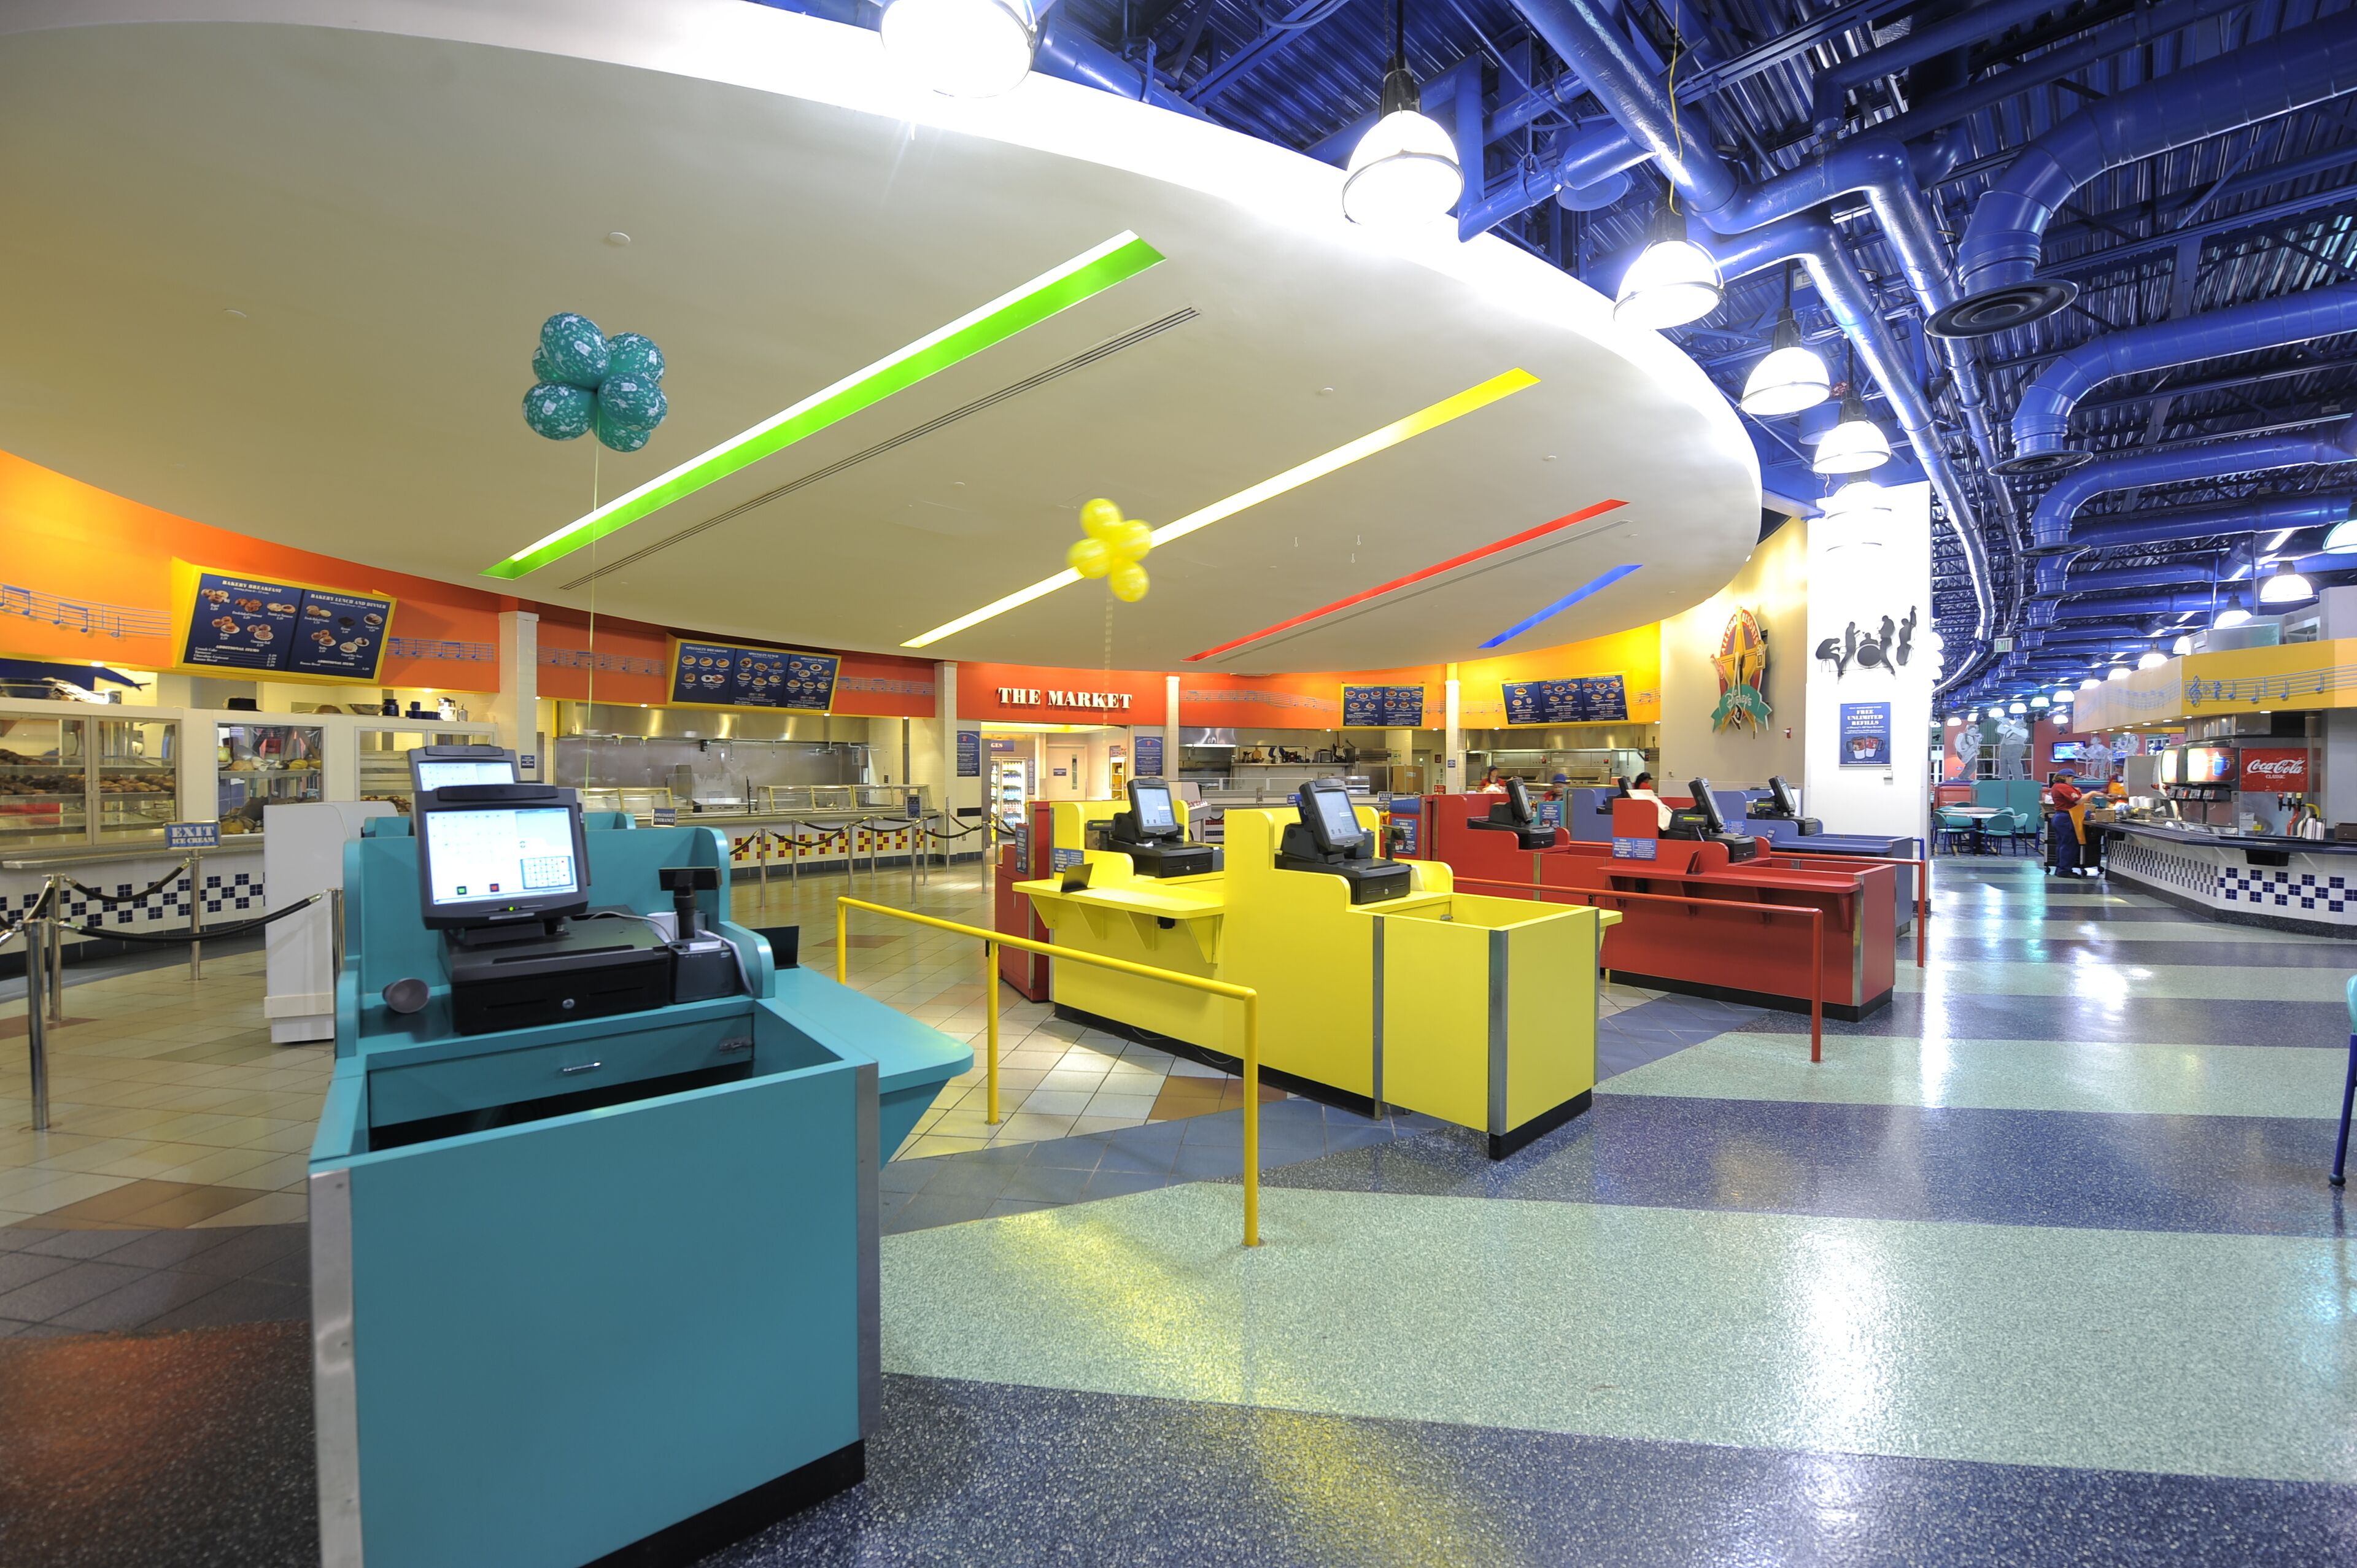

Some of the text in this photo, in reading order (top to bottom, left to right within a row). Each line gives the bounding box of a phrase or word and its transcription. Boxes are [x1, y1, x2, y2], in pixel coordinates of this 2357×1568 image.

[248, 584, 282, 593] BREAKFAST
[998, 687, 1132, 709] THE MARKET
[2247, 759, 2305, 774] Coca-Cola
[172, 826, 215, 837] EXIT
